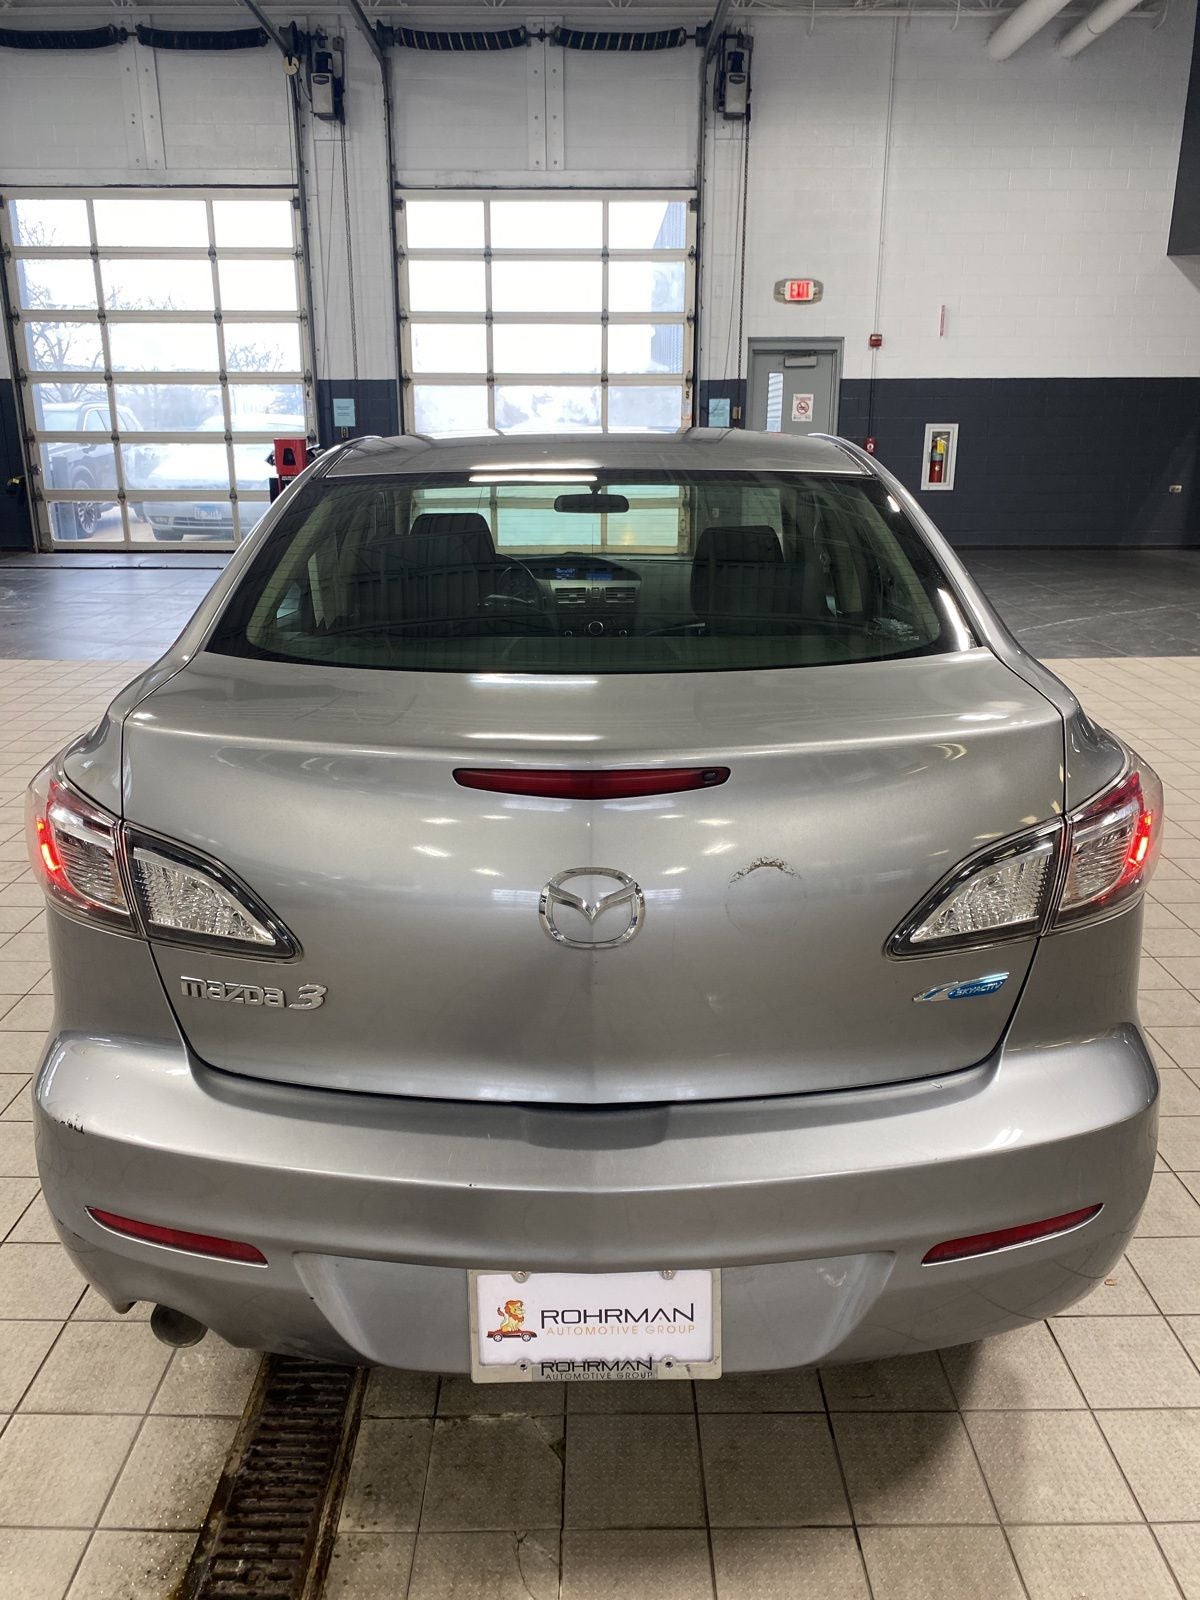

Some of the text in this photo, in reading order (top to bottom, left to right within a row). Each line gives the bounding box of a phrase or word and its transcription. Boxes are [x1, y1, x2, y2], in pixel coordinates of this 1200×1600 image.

[790, 282, 811, 299] EXIT
[288, 983, 328, 1010] 3
[540, 1302, 695, 1329] ROHRMAN
[546, 1325, 696, 1336] AUTOMOTIVE GROUP
[540, 1356, 653, 1376] ROHRMAN
[545, 1371, 653, 1380] AUTOMOTIVE GROUP
